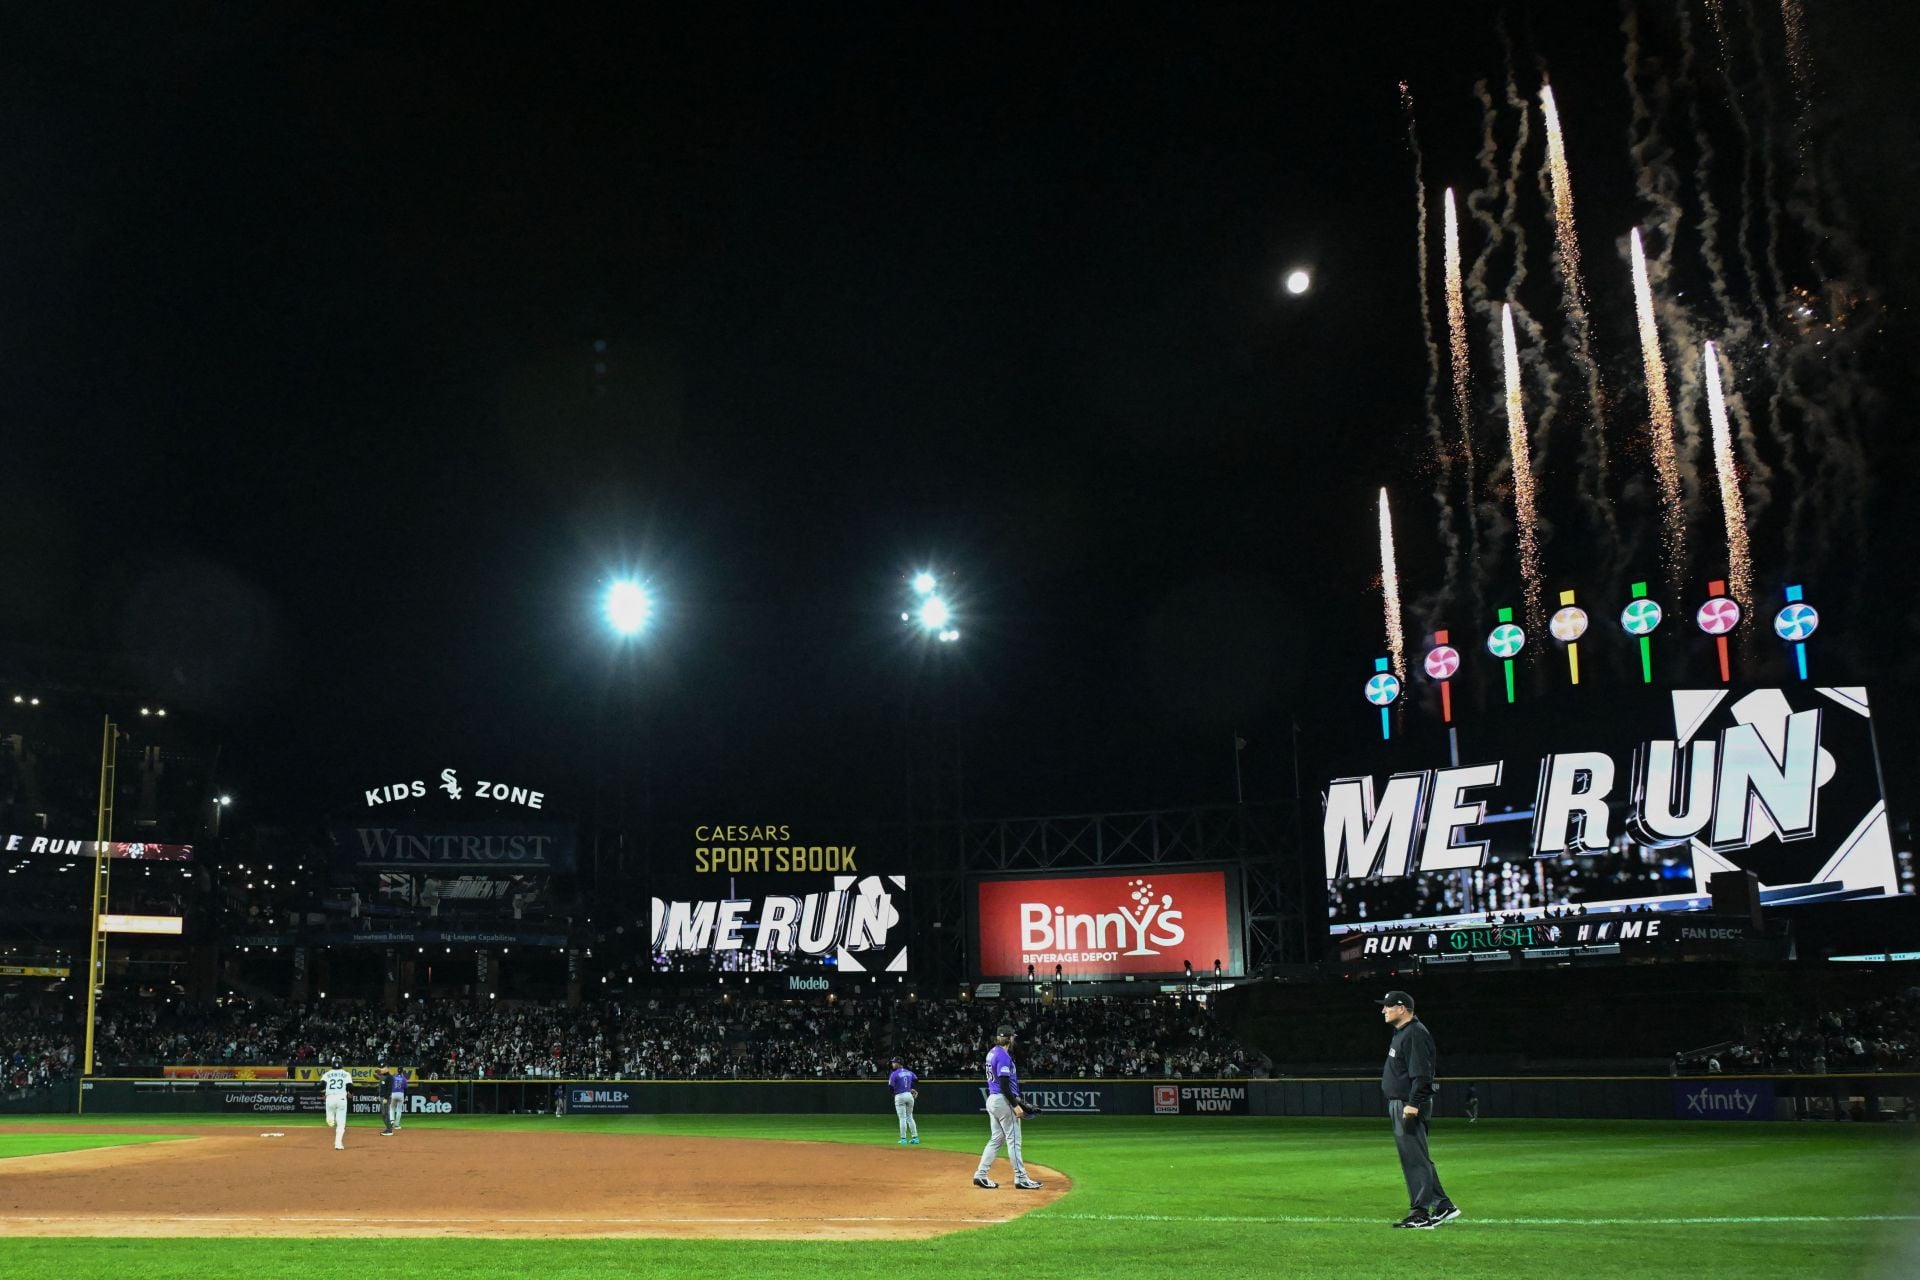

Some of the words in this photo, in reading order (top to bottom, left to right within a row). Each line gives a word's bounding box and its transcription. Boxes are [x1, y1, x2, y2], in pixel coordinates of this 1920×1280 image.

[1528, 707, 1823, 861] RUN
[365, 781, 426, 807] KIDS
[475, 781, 544, 809] ZONE
[695, 825, 790, 841] CAESARS
[30, 836, 82, 855] RUN
[695, 846, 857, 872] SPORTSBOOK
[754, 889, 892, 955] RUN
[1472, 926, 1533, 948] RUSH
[1680, 928, 1706, 939] FAN
[1363, 936, 1413, 955] RUN
[1022, 951, 1079, 963] BEVERAGE
[1081, 950, 1118, 962] DEPOT
[789, 975, 829, 990] Modelo
[351, 1069, 372, 1077] Beef
[329, 1078, 344, 1090] 23
[225, 1094, 294, 1104] UnitedService
[595, 1091, 629, 1102] MLB+
[1181, 1088, 1245, 1100] STREAM
[1686, 1087, 1758, 1114] xfinity
[253, 1103, 296, 1112] Companies
[352, 1103, 371, 1113] 100%
[371, 1103, 381, 1113] EN
[411, 1096, 452, 1113] Rate
[1196, 1100, 1232, 1112] NOW
